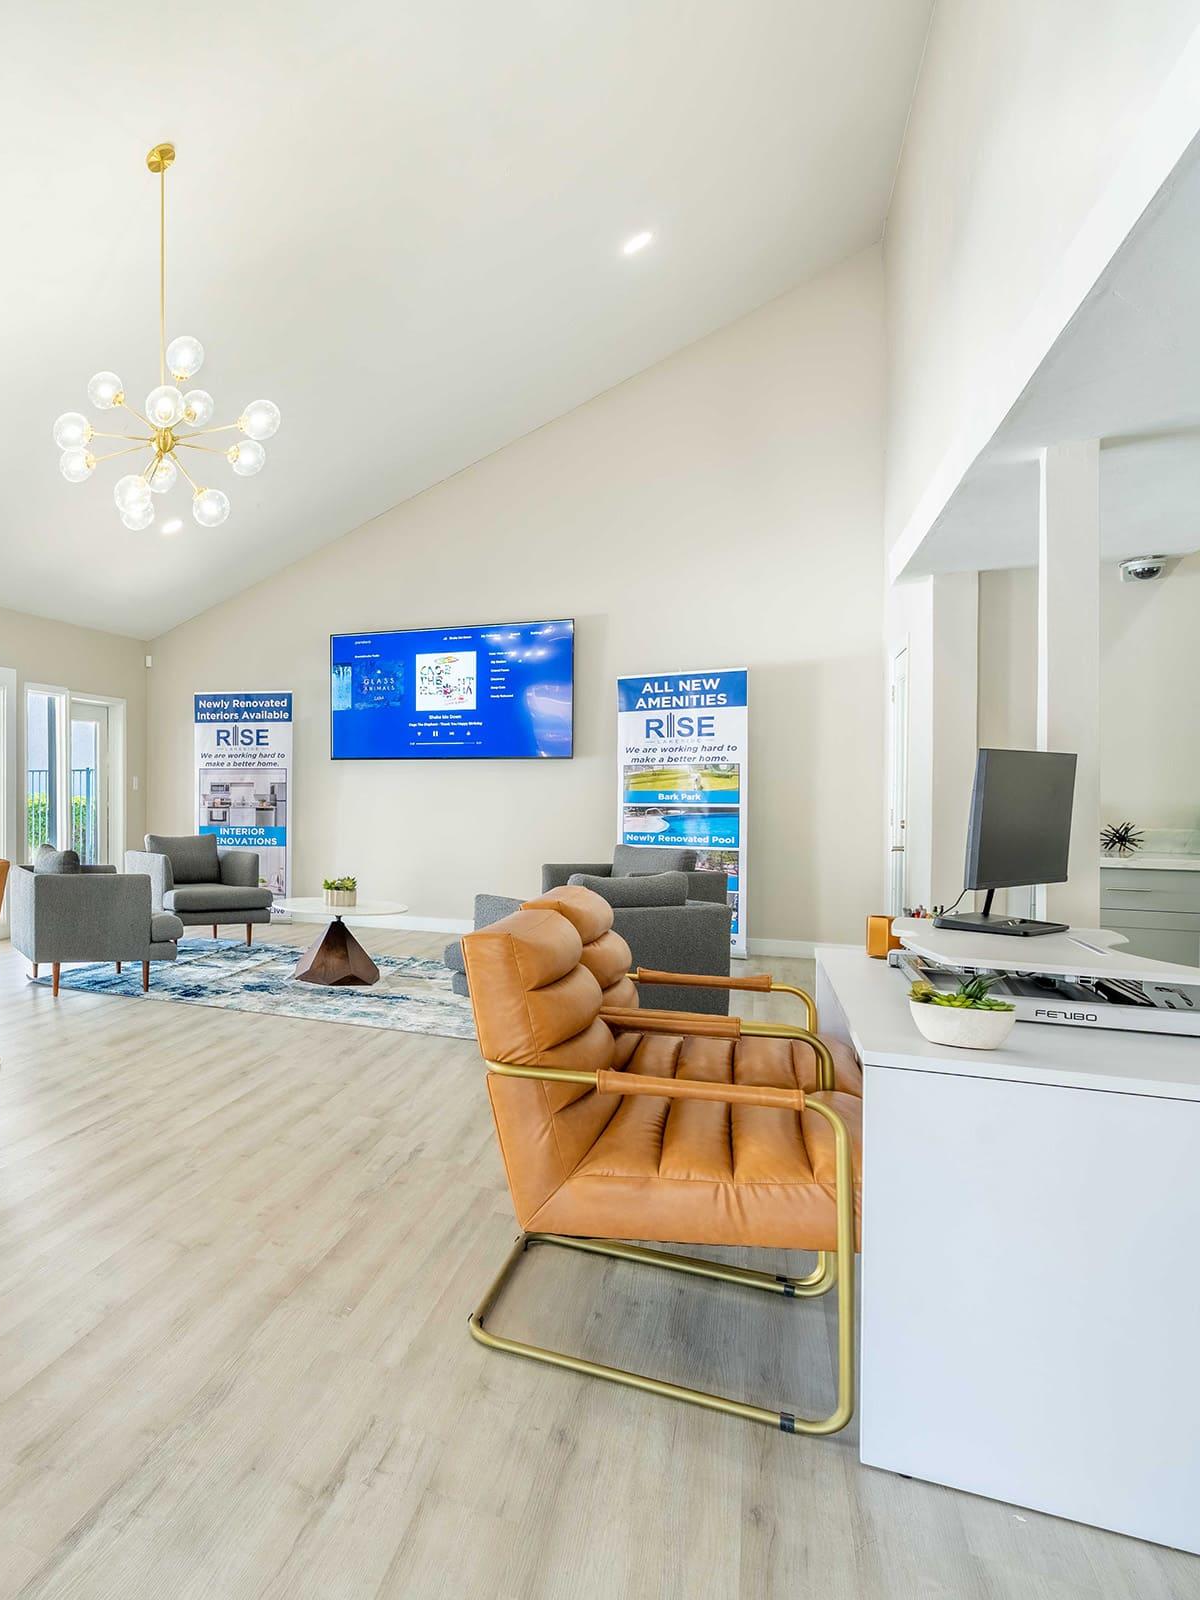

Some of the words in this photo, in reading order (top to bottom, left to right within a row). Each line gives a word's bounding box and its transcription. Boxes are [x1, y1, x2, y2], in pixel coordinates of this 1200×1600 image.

[642, 681, 674, 694] ALL
[679, 678, 720, 692] NEW
[199, 700, 230, 709] Newly
[233, 698, 288, 708] Renovated
[635, 693, 728, 709] AMENITIES
[197, 711, 239, 720] Interiors
[241, 710, 289, 719] Available
[645, 713, 715, 739] RISE
[216, 725, 269, 746] RISE
[660, 745, 698, 754] working
[701, 744, 724, 752] hard
[631, 756, 656, 764] make
[667, 755, 696, 763] better
[700, 754, 729, 762] home.
[626, 834, 656, 843] Newly
[658, 834, 708, 843] Renovated
[711, 836, 735, 844] Pool
